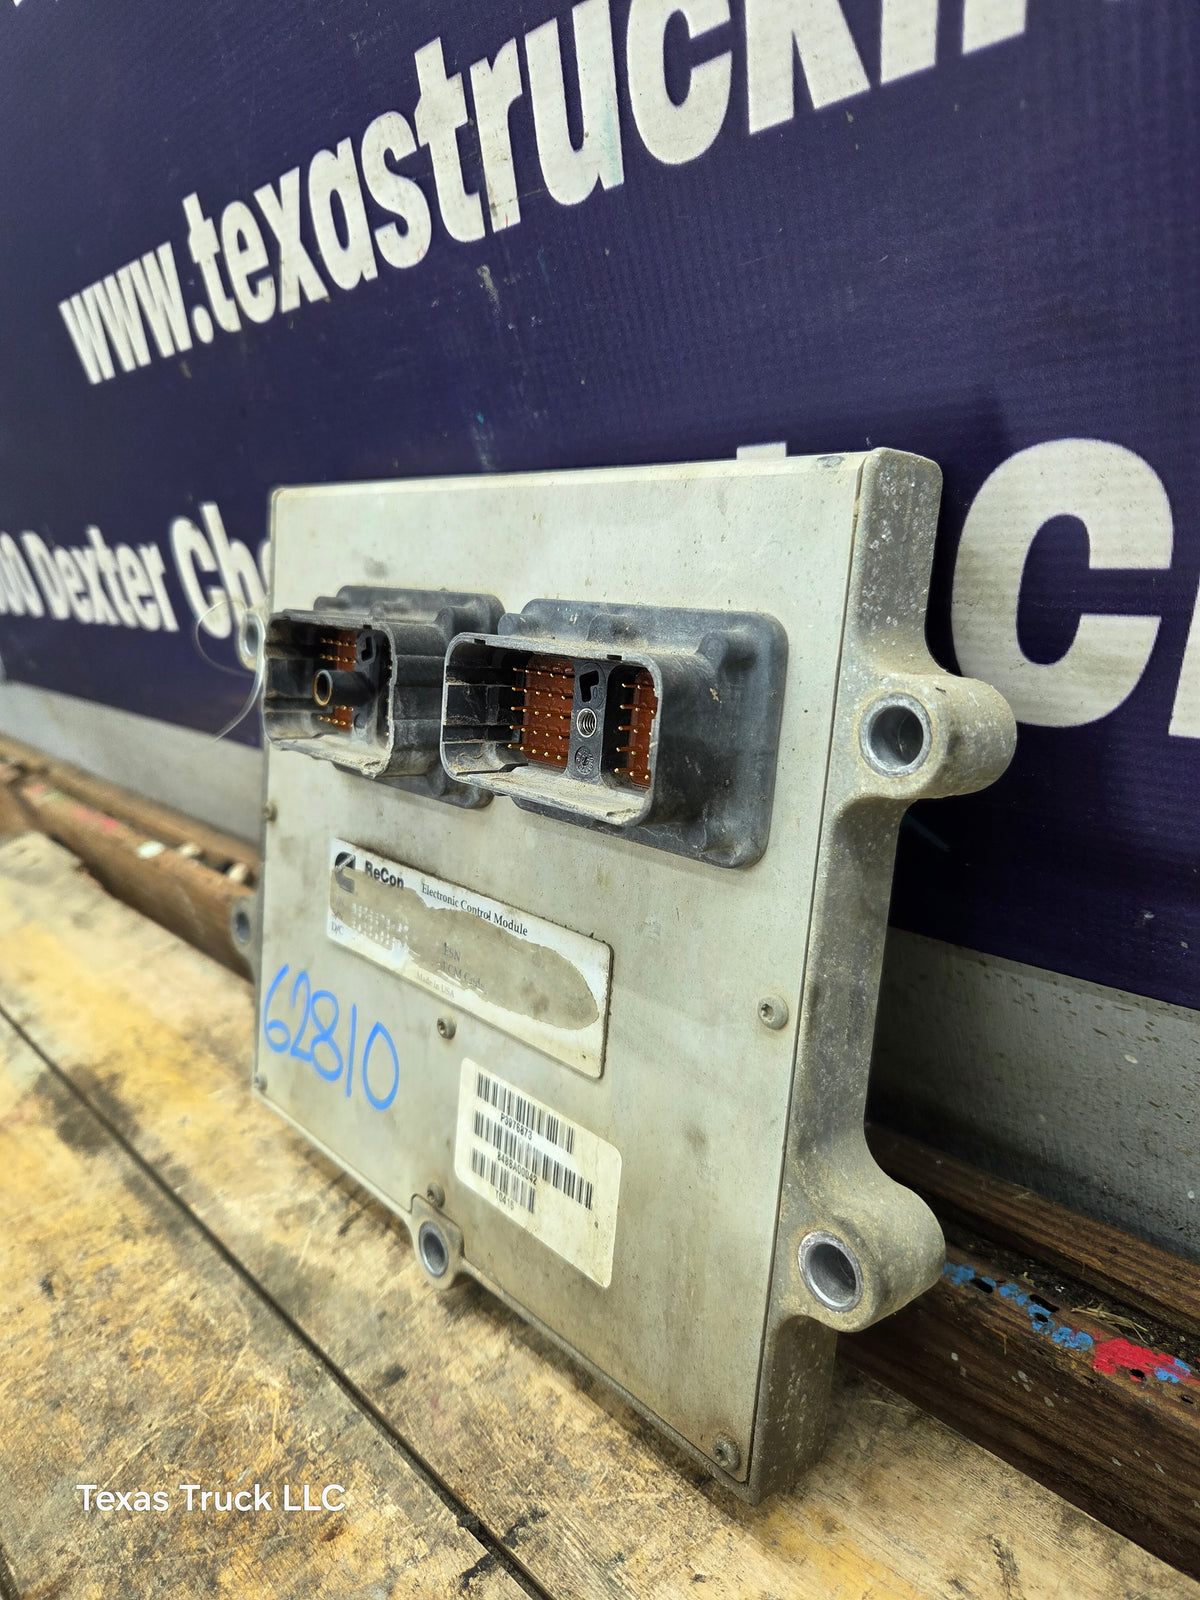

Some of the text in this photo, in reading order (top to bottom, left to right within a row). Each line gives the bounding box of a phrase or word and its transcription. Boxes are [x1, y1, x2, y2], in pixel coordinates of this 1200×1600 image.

[20, 524, 179, 632] Dexter
[364, 859, 405, 890] ReCon
[421, 882, 529, 937] Electronic Control Module
[263, 964, 399, 1111] 62810
